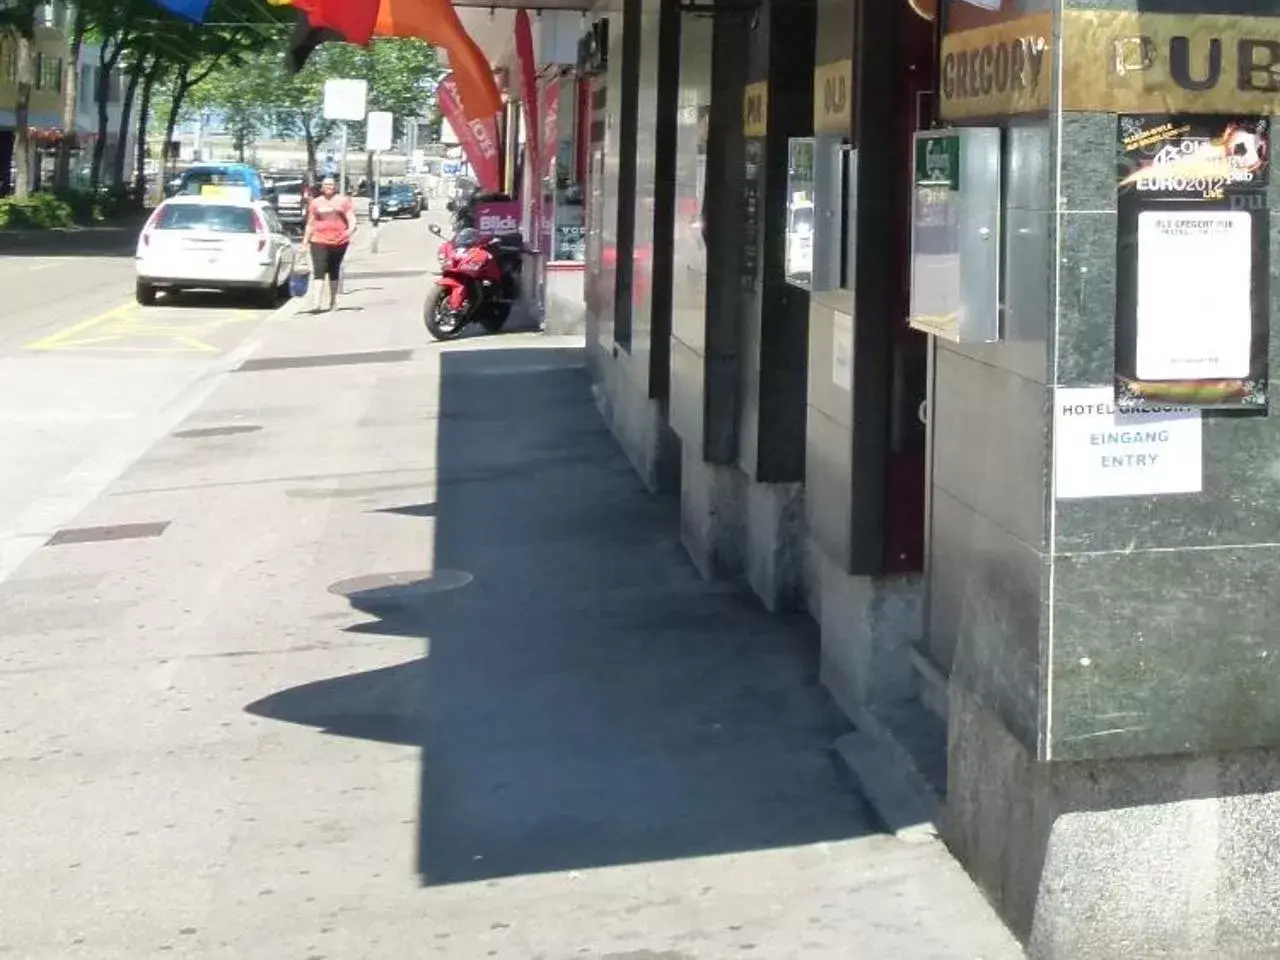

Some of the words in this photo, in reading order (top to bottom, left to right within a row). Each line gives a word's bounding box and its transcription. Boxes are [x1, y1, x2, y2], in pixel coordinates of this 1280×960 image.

[942, 38, 1045, 102] GREGORY
[1062, 402, 1115, 417] HOTEL
[1089, 429, 1170, 446] EINGANG
[1101, 453, 1160, 468] ENTRY
